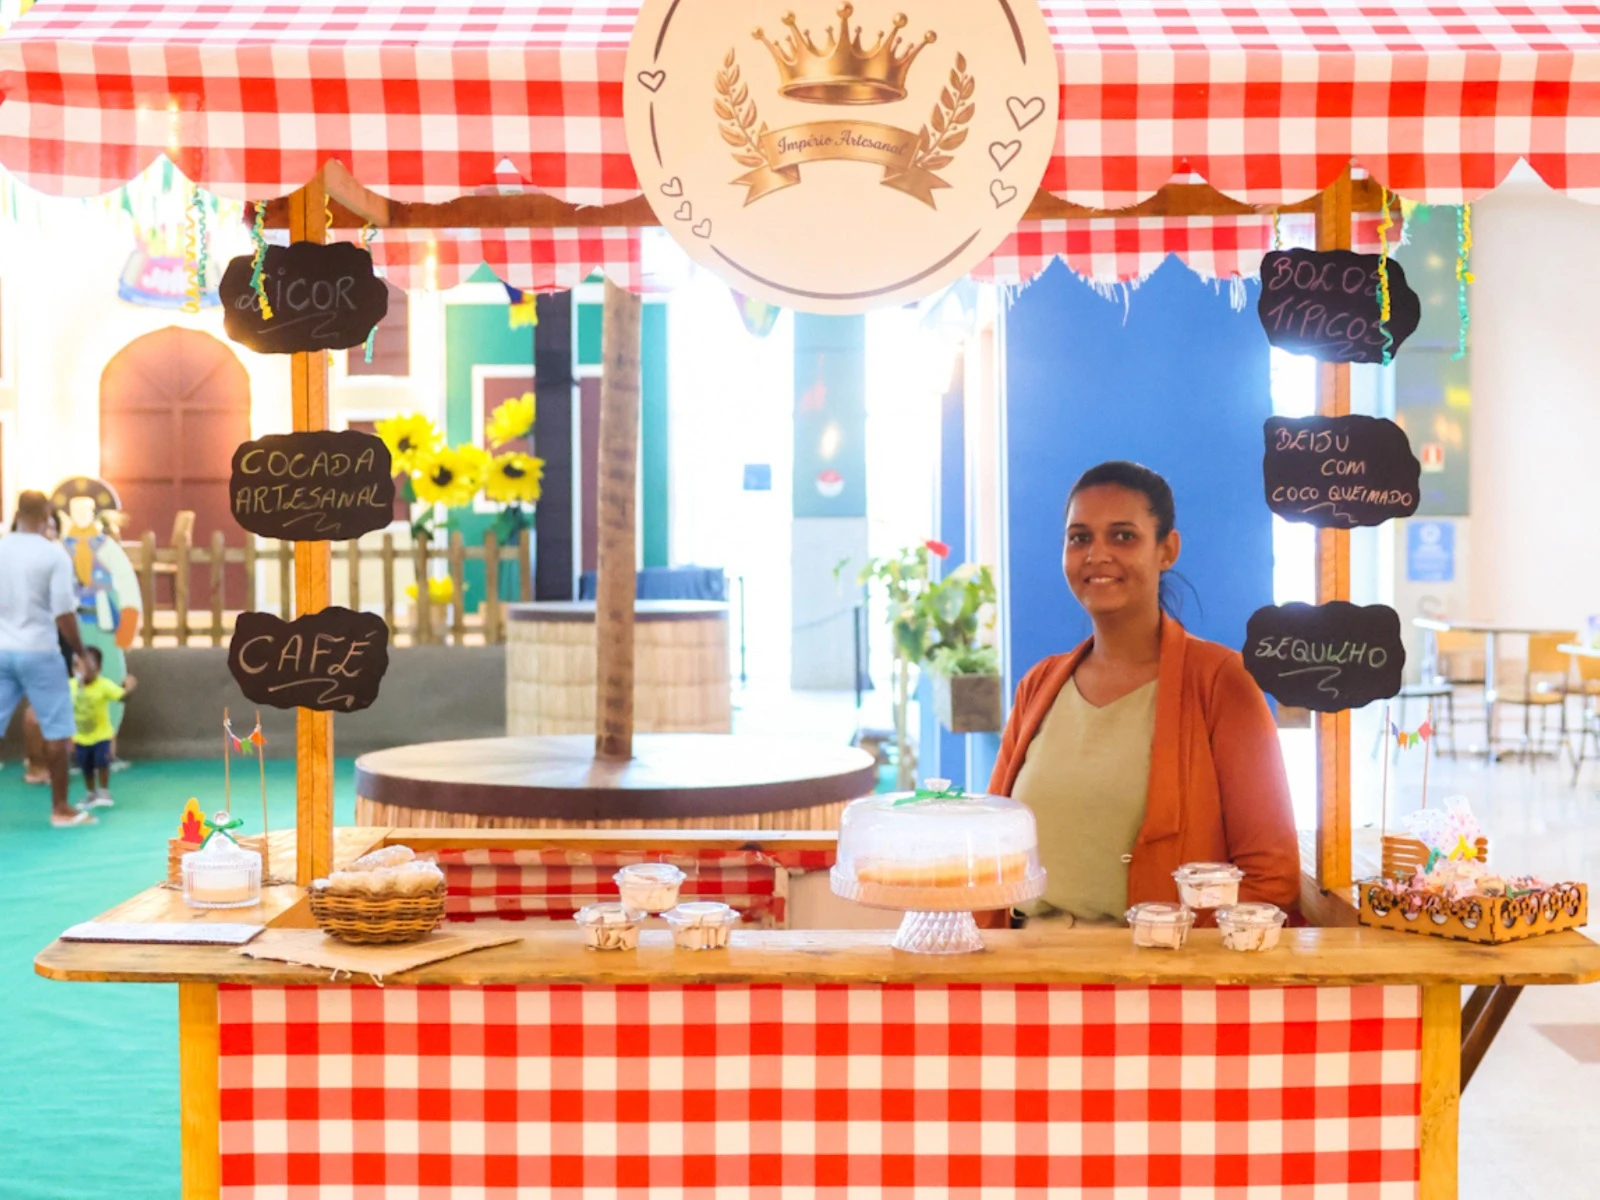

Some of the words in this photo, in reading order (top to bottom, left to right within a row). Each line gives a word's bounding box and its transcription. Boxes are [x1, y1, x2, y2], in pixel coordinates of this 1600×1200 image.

[777, 134, 832, 154] Império
[835, 129, 909, 155] Artesanal
[240, 447, 375, 479] COCADA
[1321, 459, 1367, 476] COM
[235, 482, 387, 515] ARTESANAL
[1272, 486, 1319, 502] COCO
[1328, 485, 1413, 507] QUEIMADO
[238, 629, 378, 678] CAFÉ
[1255, 636, 1388, 669] SEQUILHO
